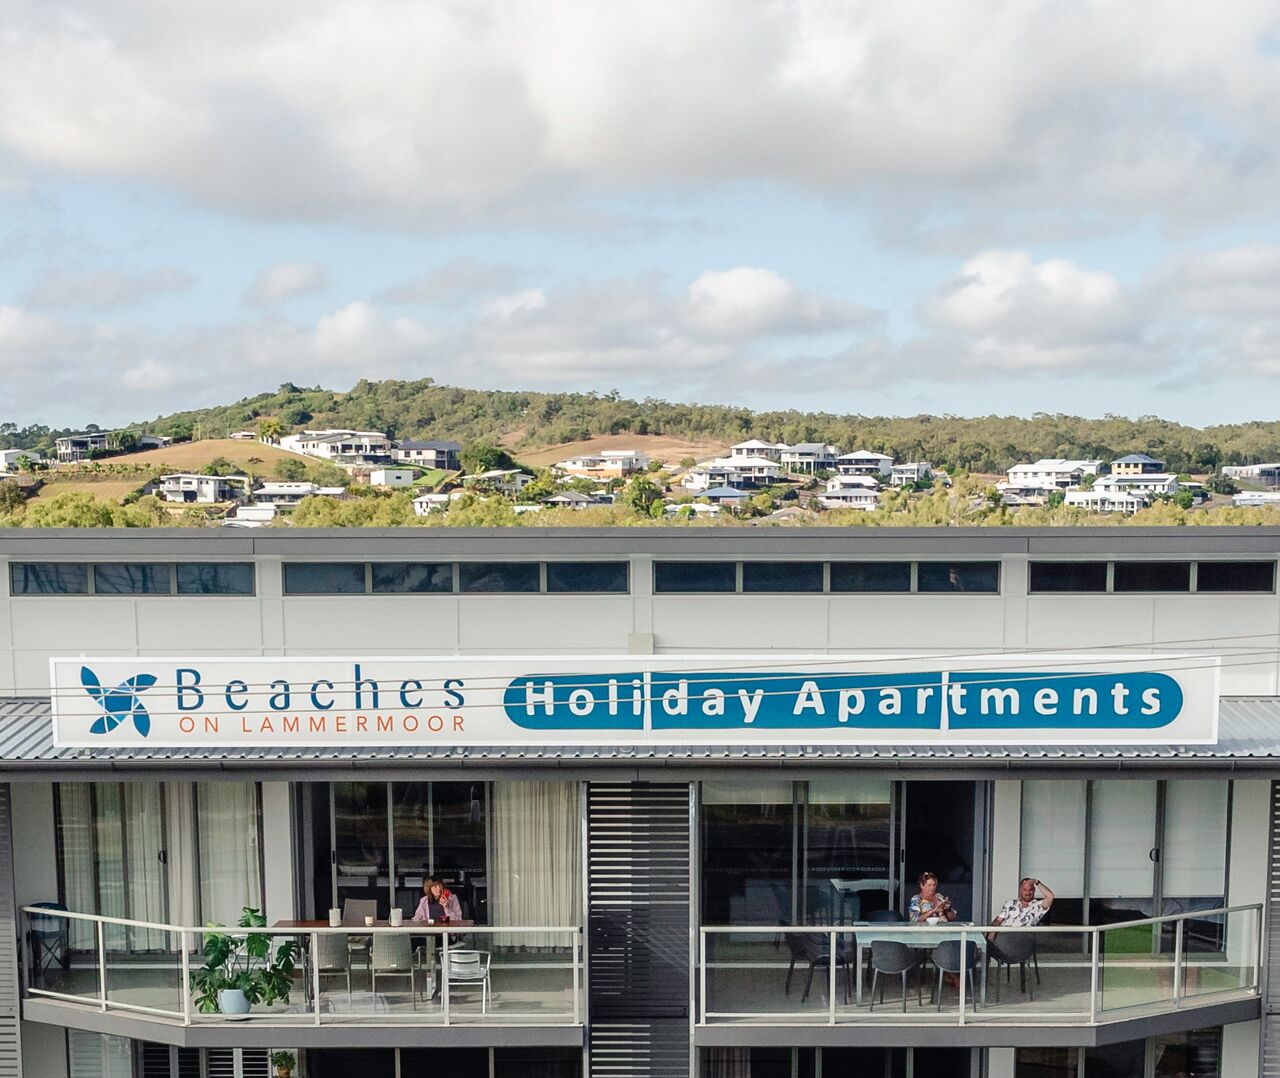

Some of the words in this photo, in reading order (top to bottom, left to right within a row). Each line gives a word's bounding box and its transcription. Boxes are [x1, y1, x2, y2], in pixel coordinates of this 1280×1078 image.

[176, 664, 466, 711] Beaches
[525, 679, 764, 723] Holiday
[793, 681, 1161, 722] Apartments
[179, 716, 219, 733] ON
[241, 714, 465, 733] LAMMERMOOR
